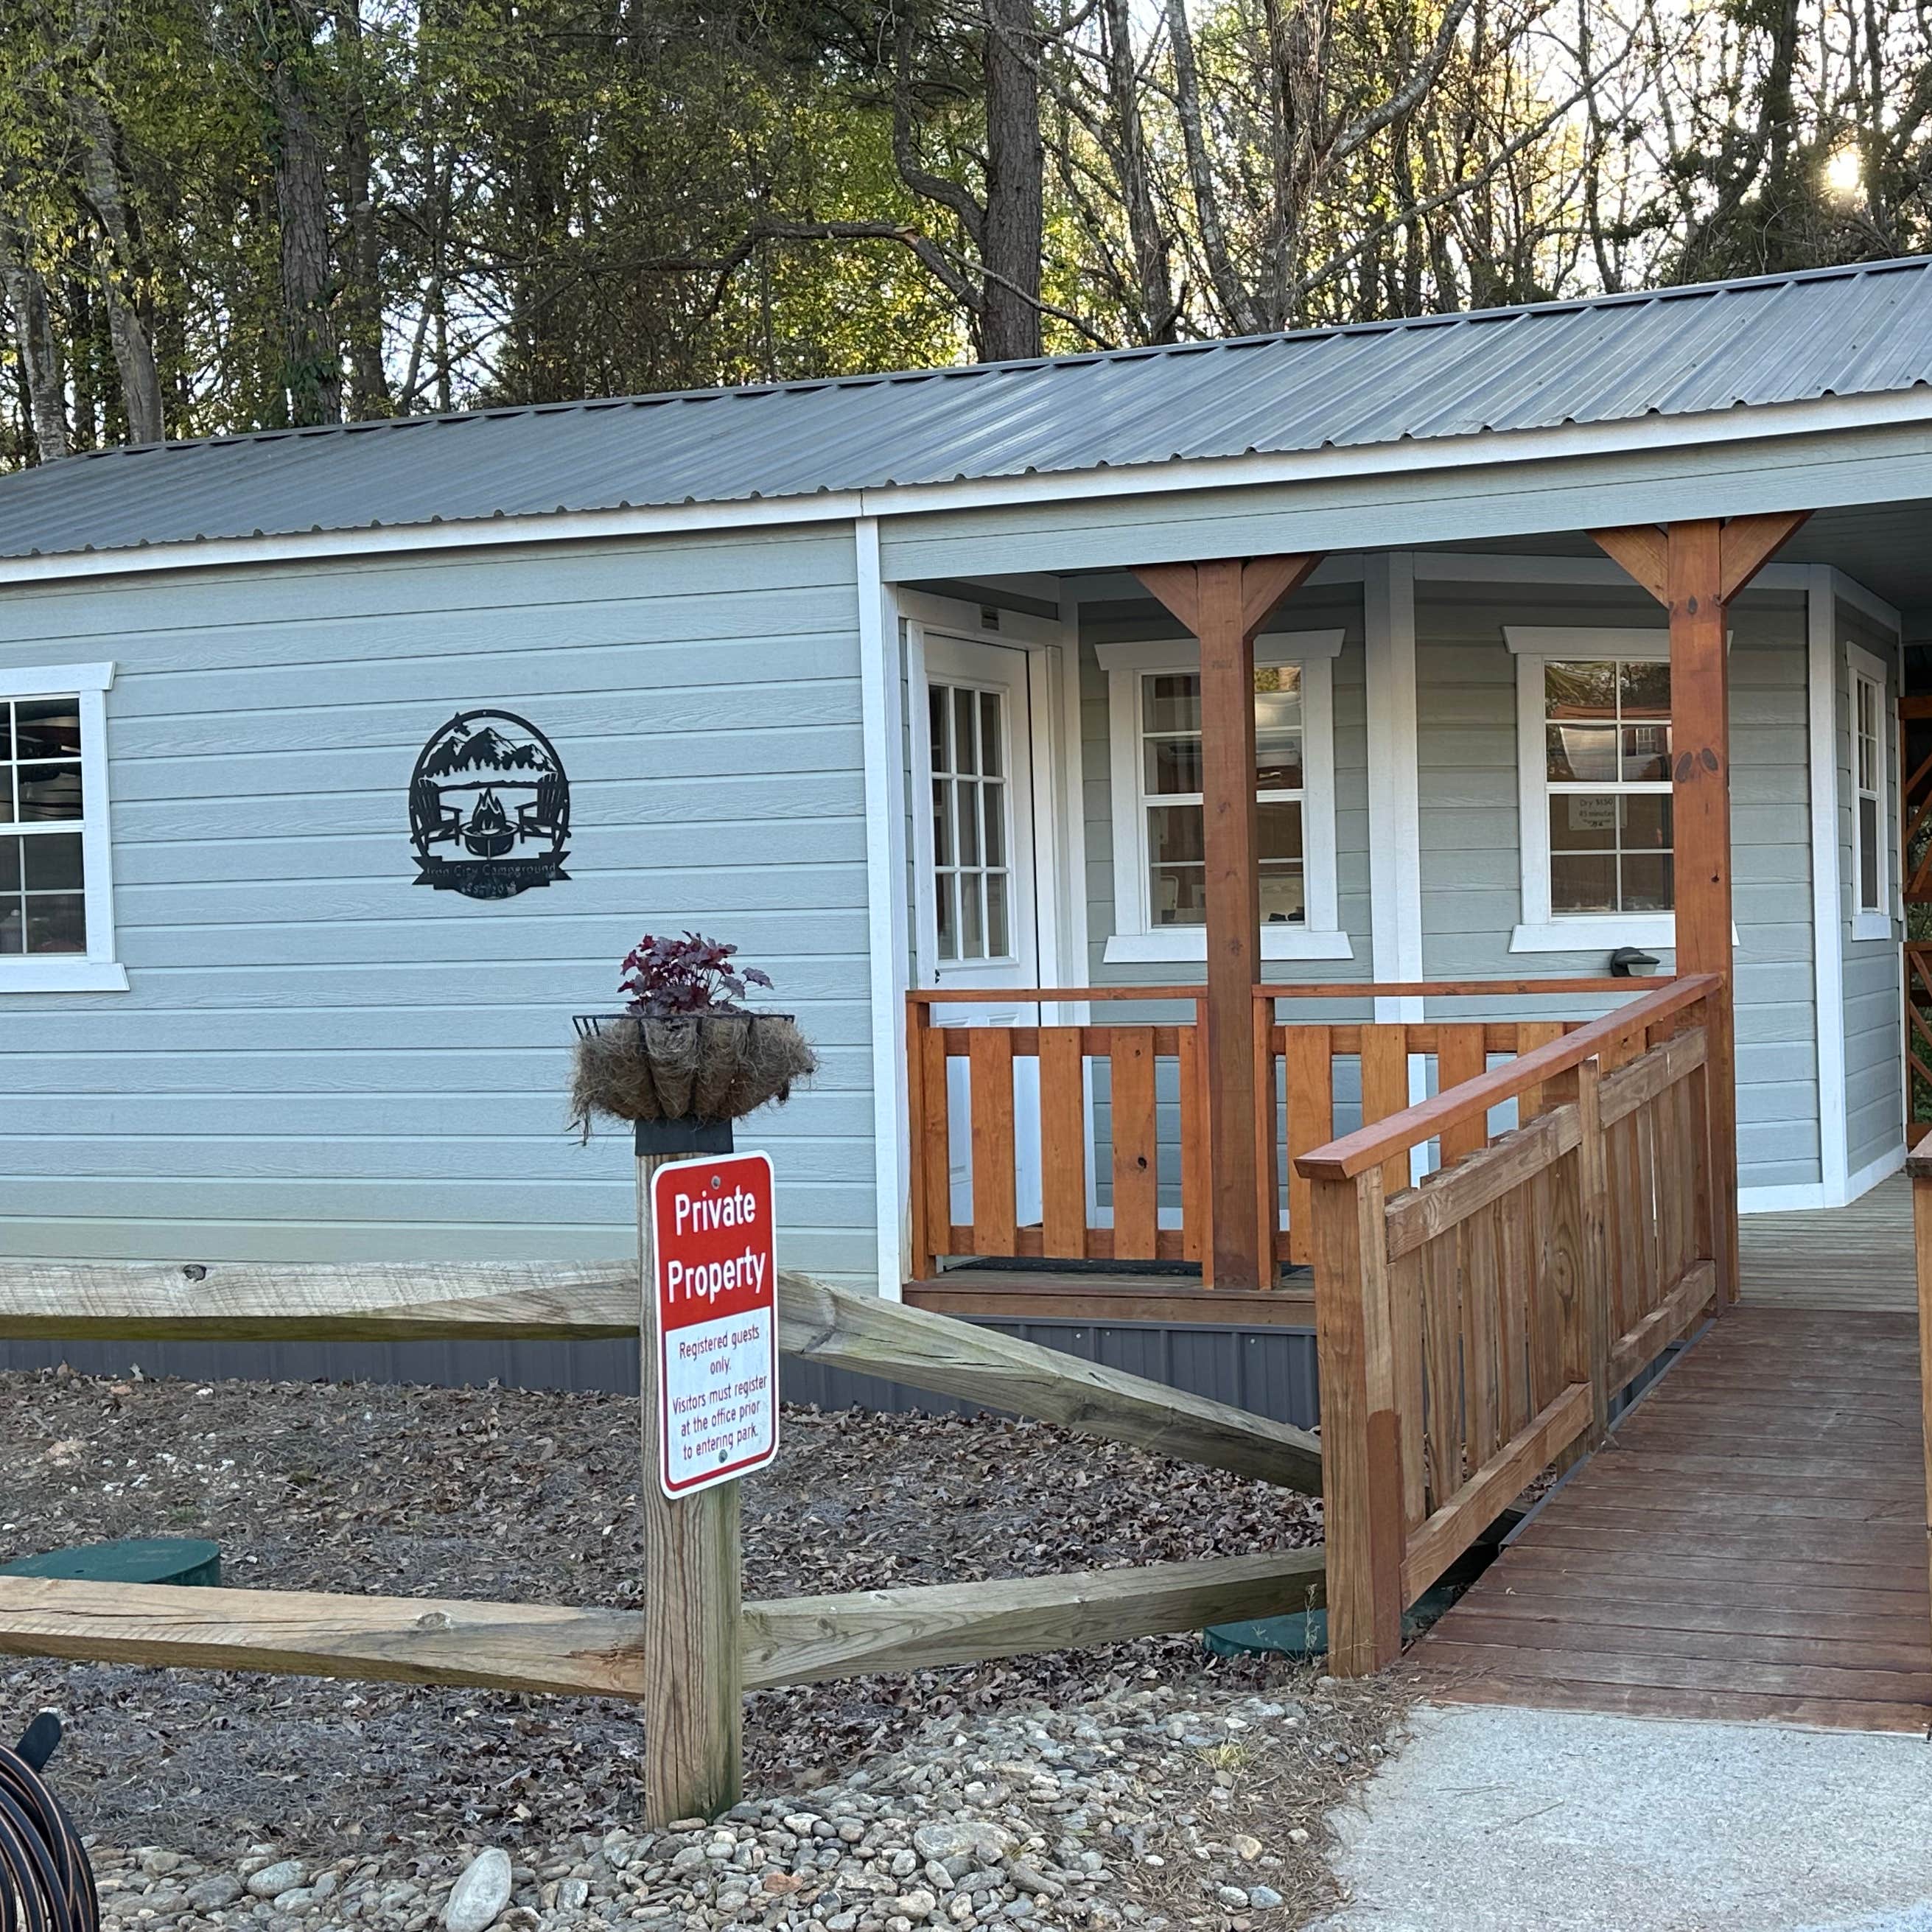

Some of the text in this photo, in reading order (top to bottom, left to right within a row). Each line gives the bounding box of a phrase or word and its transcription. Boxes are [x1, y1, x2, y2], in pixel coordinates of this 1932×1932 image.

[1580, 799, 1592, 808] Dry
[427, 863, 556, 878] Iron City Campground
[675, 1185, 756, 1236] Private
[668, 1246, 766, 1304] Property
[679, 1324, 760, 1362] Registered guests
[710, 1356, 732, 1375] only.
[672, 1374, 767, 1415] Visitors must register
[681, 1399, 760, 1437] at the office prior
[683, 1422, 758, 1460] to entering park.
